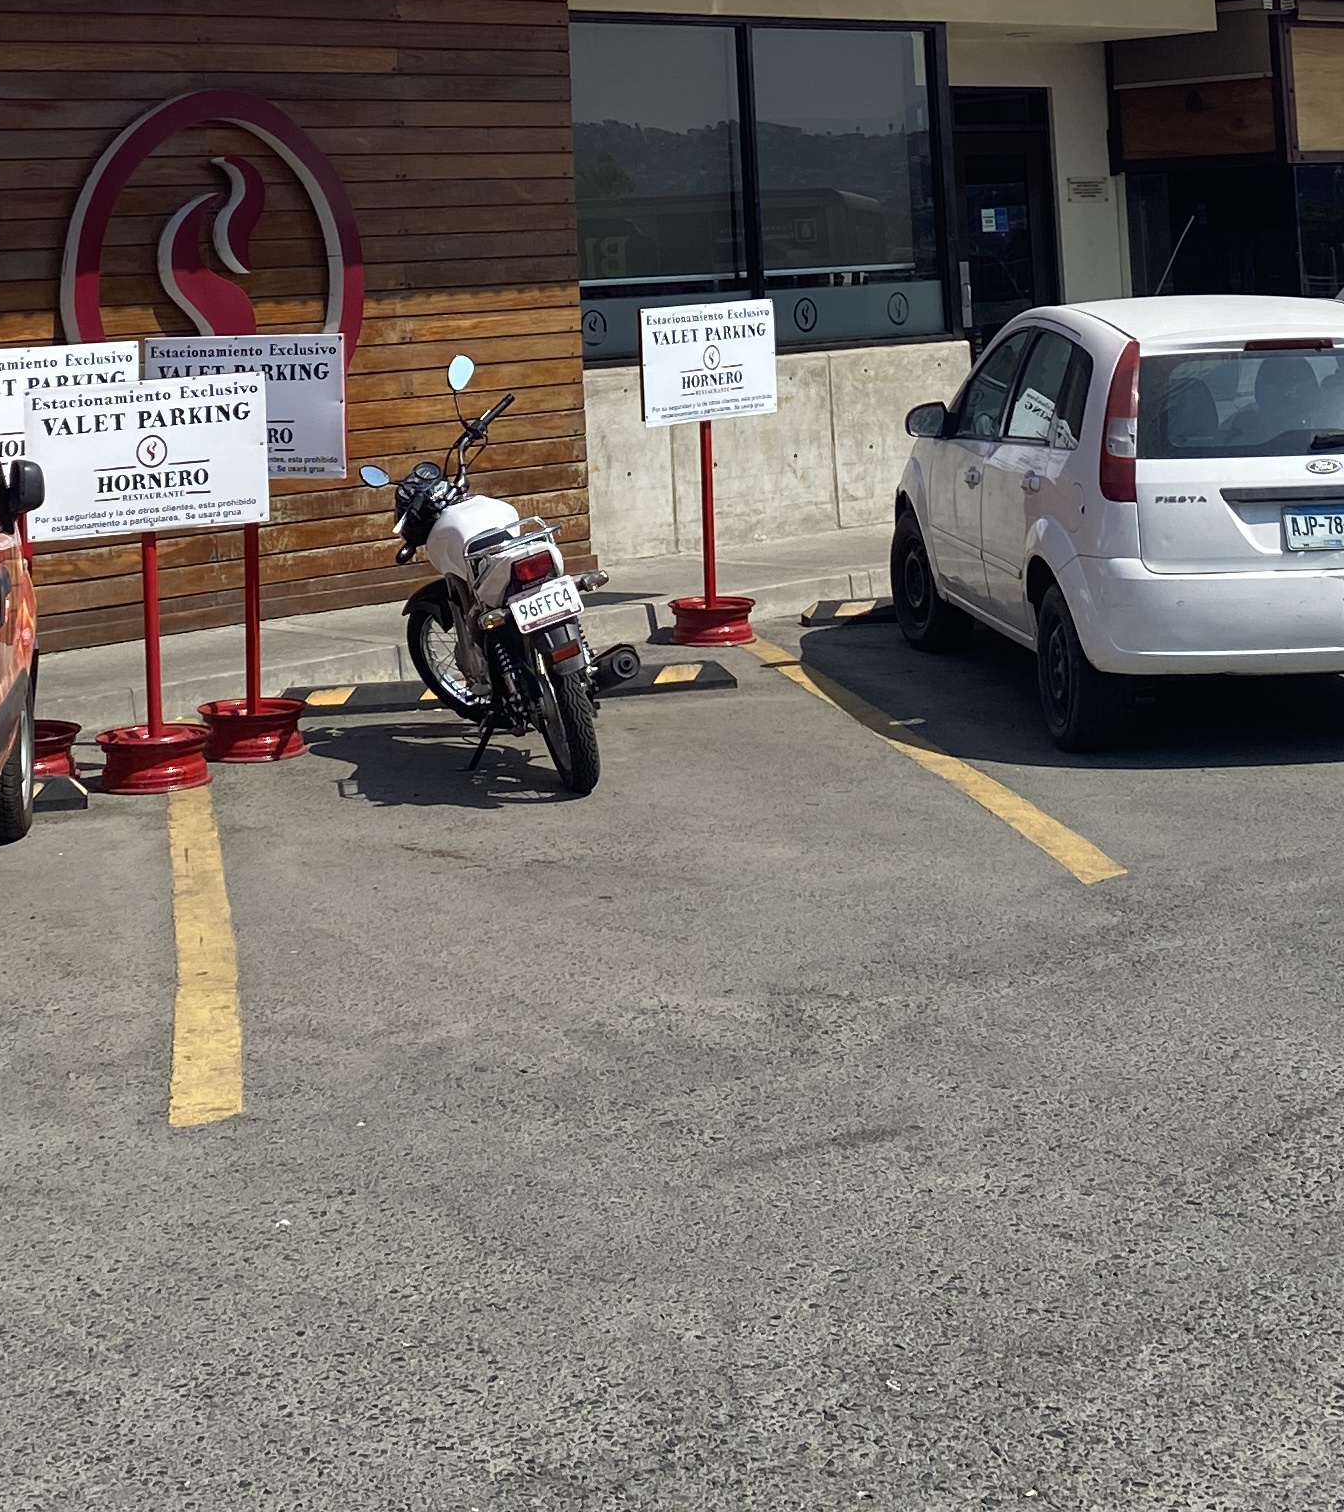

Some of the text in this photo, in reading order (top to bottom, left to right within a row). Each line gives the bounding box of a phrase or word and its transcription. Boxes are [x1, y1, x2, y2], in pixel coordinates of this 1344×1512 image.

[645, 308, 770, 327] Estacionamiento Exclusivo
[652, 322, 766, 346] VALET PARKING
[65, 351, 133, 367] Exclusivo
[150, 342, 337, 359] Estacionamiento Exclusivo
[681, 370, 743, 390] HORNERO
[31, 381, 258, 411] Estacionamiento Exclusivo
[41, 401, 251, 436] VALET PARKING
[96, 468, 209, 494] HORNERO
[122, 489, 185, 502] RESTAURANTE
[1154, 494, 1207, 504] FIESTA
[35, 516, 50, 524] Por
[65, 510, 107, 522] seguridad
[125, 508, 136, 516] de
[137, 506, 160, 515] otros
[161, 504, 196, 513] clientes,
[197, 501, 216, 509] esta
[217, 498, 257, 508] prohibido
[51, 520, 120, 532] estacionamiento
[185, 512, 196, 520] Se
[518, 587, 573, 621] 96FFC4
